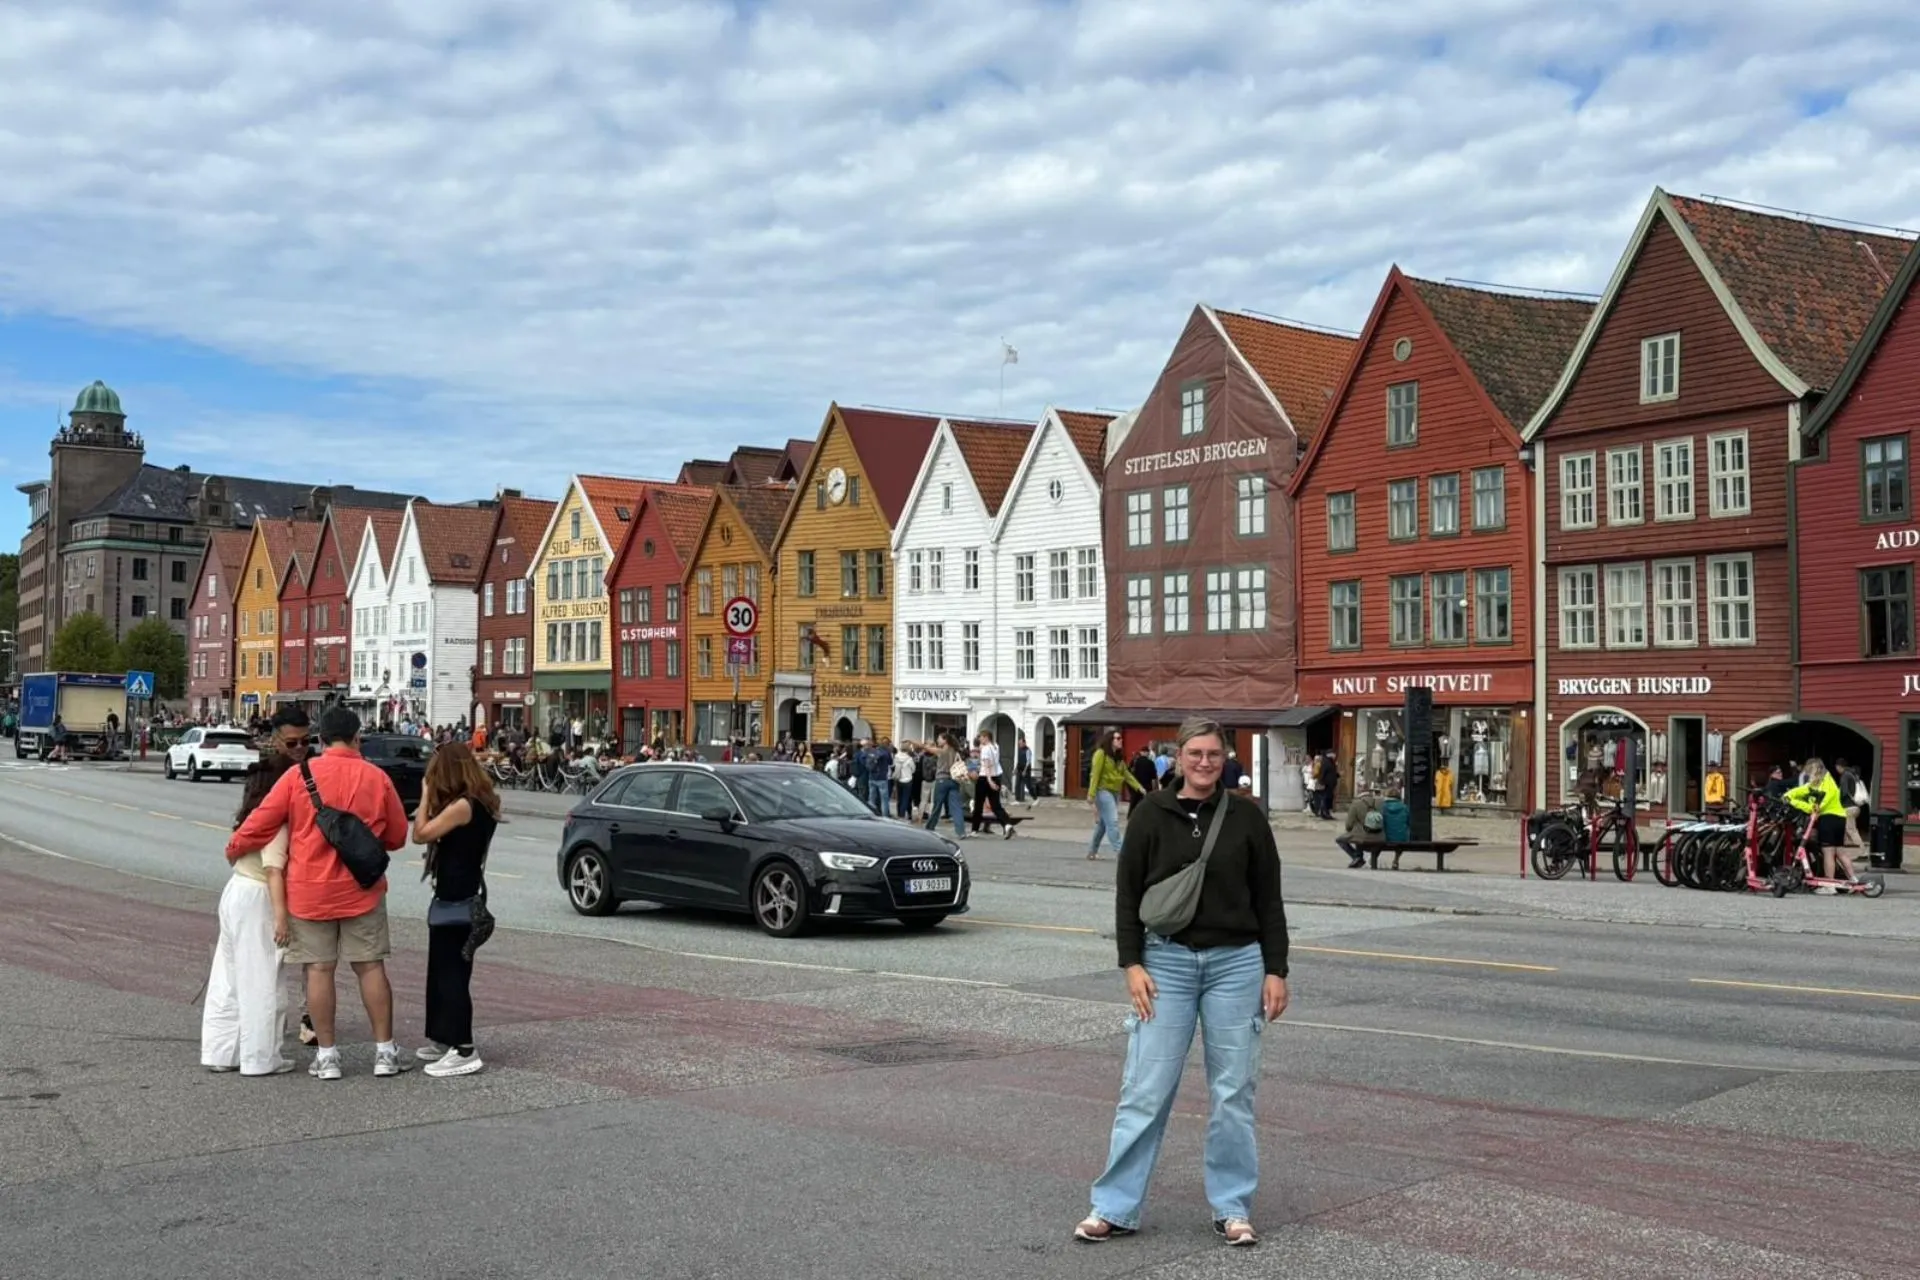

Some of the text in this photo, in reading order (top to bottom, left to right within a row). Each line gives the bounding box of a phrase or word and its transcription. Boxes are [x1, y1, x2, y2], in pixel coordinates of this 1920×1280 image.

[1124, 437, 1268, 475] STIFTELSEN BRYGGEN
[551, 536, 601, 556] SILD FISK
[541, 601, 609, 619] ALFRED SKULSTAD
[730, 606, 752, 627] 30
[630, 626, 677, 640] STORHEIM
[1332, 673, 1493, 695] KNUT SKURTVEIT
[1558, 676, 1712, 695] BRYGGEN HUSFLID
